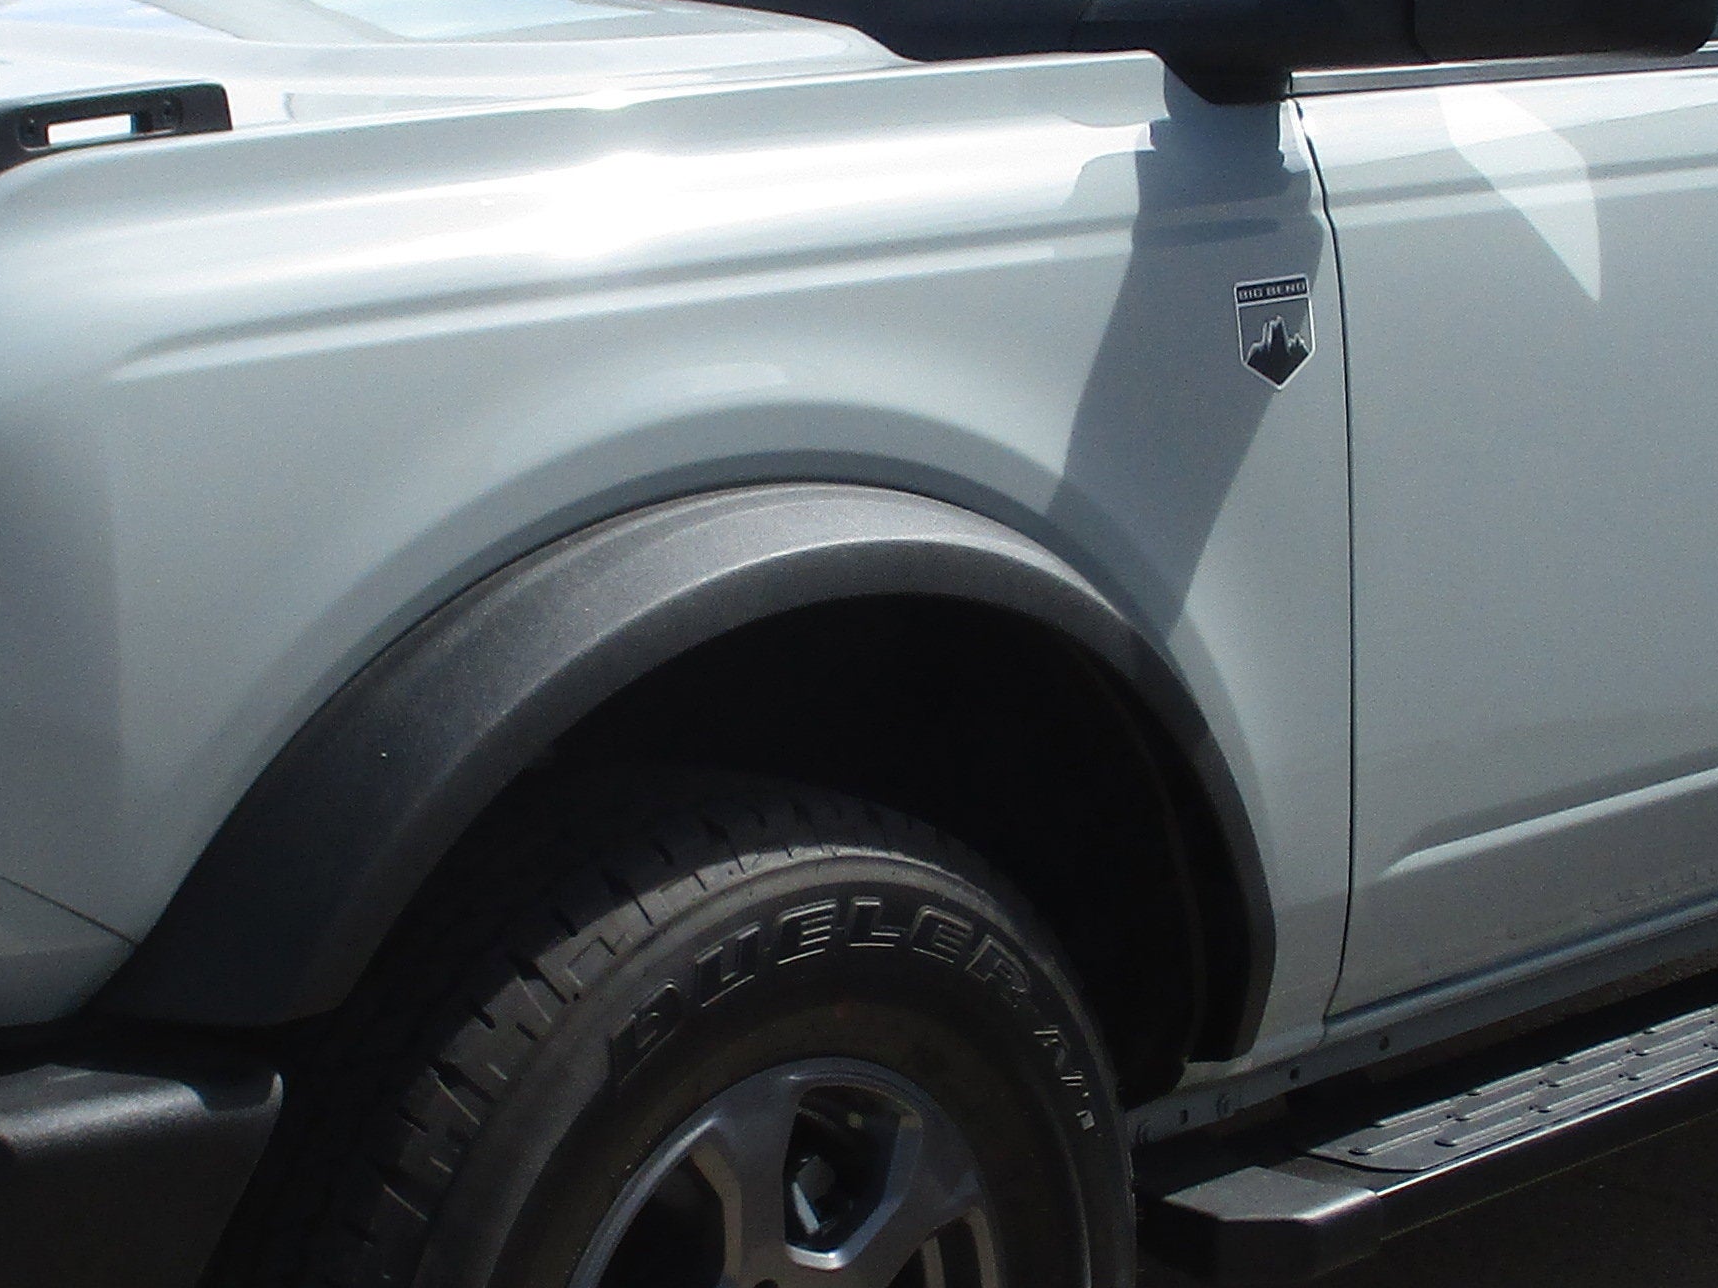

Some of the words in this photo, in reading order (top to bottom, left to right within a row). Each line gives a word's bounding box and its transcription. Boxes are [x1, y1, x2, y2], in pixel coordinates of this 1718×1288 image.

[1238, 288, 1263, 300] BIG
[1266, 282, 1305, 296] BEND
[609, 896, 1032, 1088] DUELER
